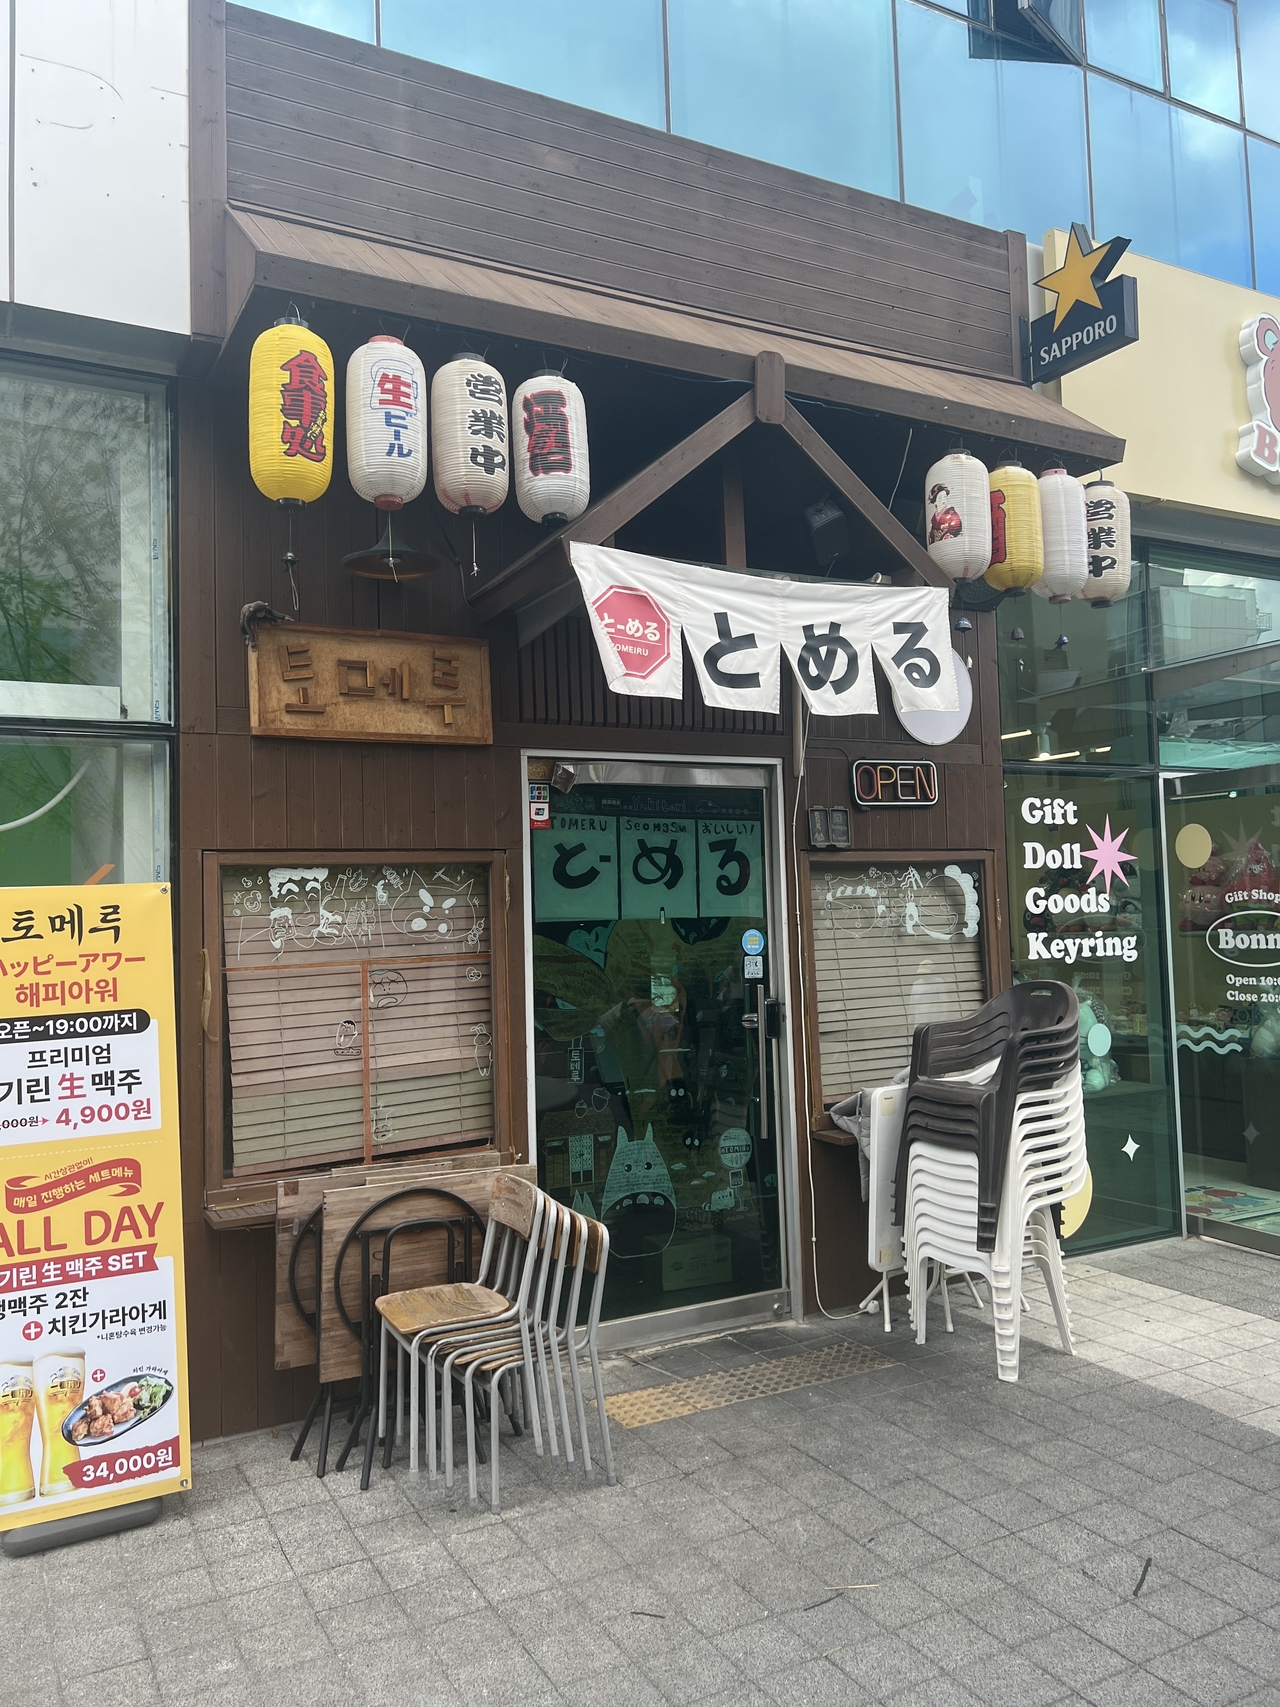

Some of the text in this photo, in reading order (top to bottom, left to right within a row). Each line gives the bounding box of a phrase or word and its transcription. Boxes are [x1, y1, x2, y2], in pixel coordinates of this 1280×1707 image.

[1039, 314, 1118, 366] SAPPORO
[280, 350, 327, 462] 食事処
[377, 371, 413, 458] 生ビール
[465, 372, 506, 475] 営業中
[614, 643, 649, 656] OMEIRU
[279, 642, 468, 725] 토메루
[857, 765, 935, 800] OPEN
[632, 796, 687, 812] Yakitori
[1021, 797, 1078, 825] Gift
[550, 816, 608, 832] TOMERU
[1023, 842, 1082, 869] Doll
[1025, 887, 1110, 914] Goods
[1225, 889, 1280, 904] Gift Shop
[1, 903, 122, 946] 토메루
[1027, 931, 1138, 964] Keyring
[15, 977, 118, 1007] 해피아워
[1226, 974, 1257, 986] Open
[1226, 990, 1280, 1002] Close 20:
[27, 1044, 112, 1069] 프리미엄
[570, 1050, 581, 1082] 토메루
[0, 1068, 143, 1105] 기린 生 맥주
[56, 1098, 152, 1130] 4,900원
[44, 1157, 94, 1181] 시간상관없이!
[13, 1167, 134, 1208] 매일 진행하는 세트메뉴
[84, 1202, 165, 1246] DAY
[0, 1250, 148, 1288] 기린 生 맥주 SET
[55, 1287, 89, 1309] 2잔
[47, 1300, 168, 1337] 치킨가라아게
[139, 1324, 167, 1335] 변경가능
[82, 1447, 173, 1482] 34,000원
